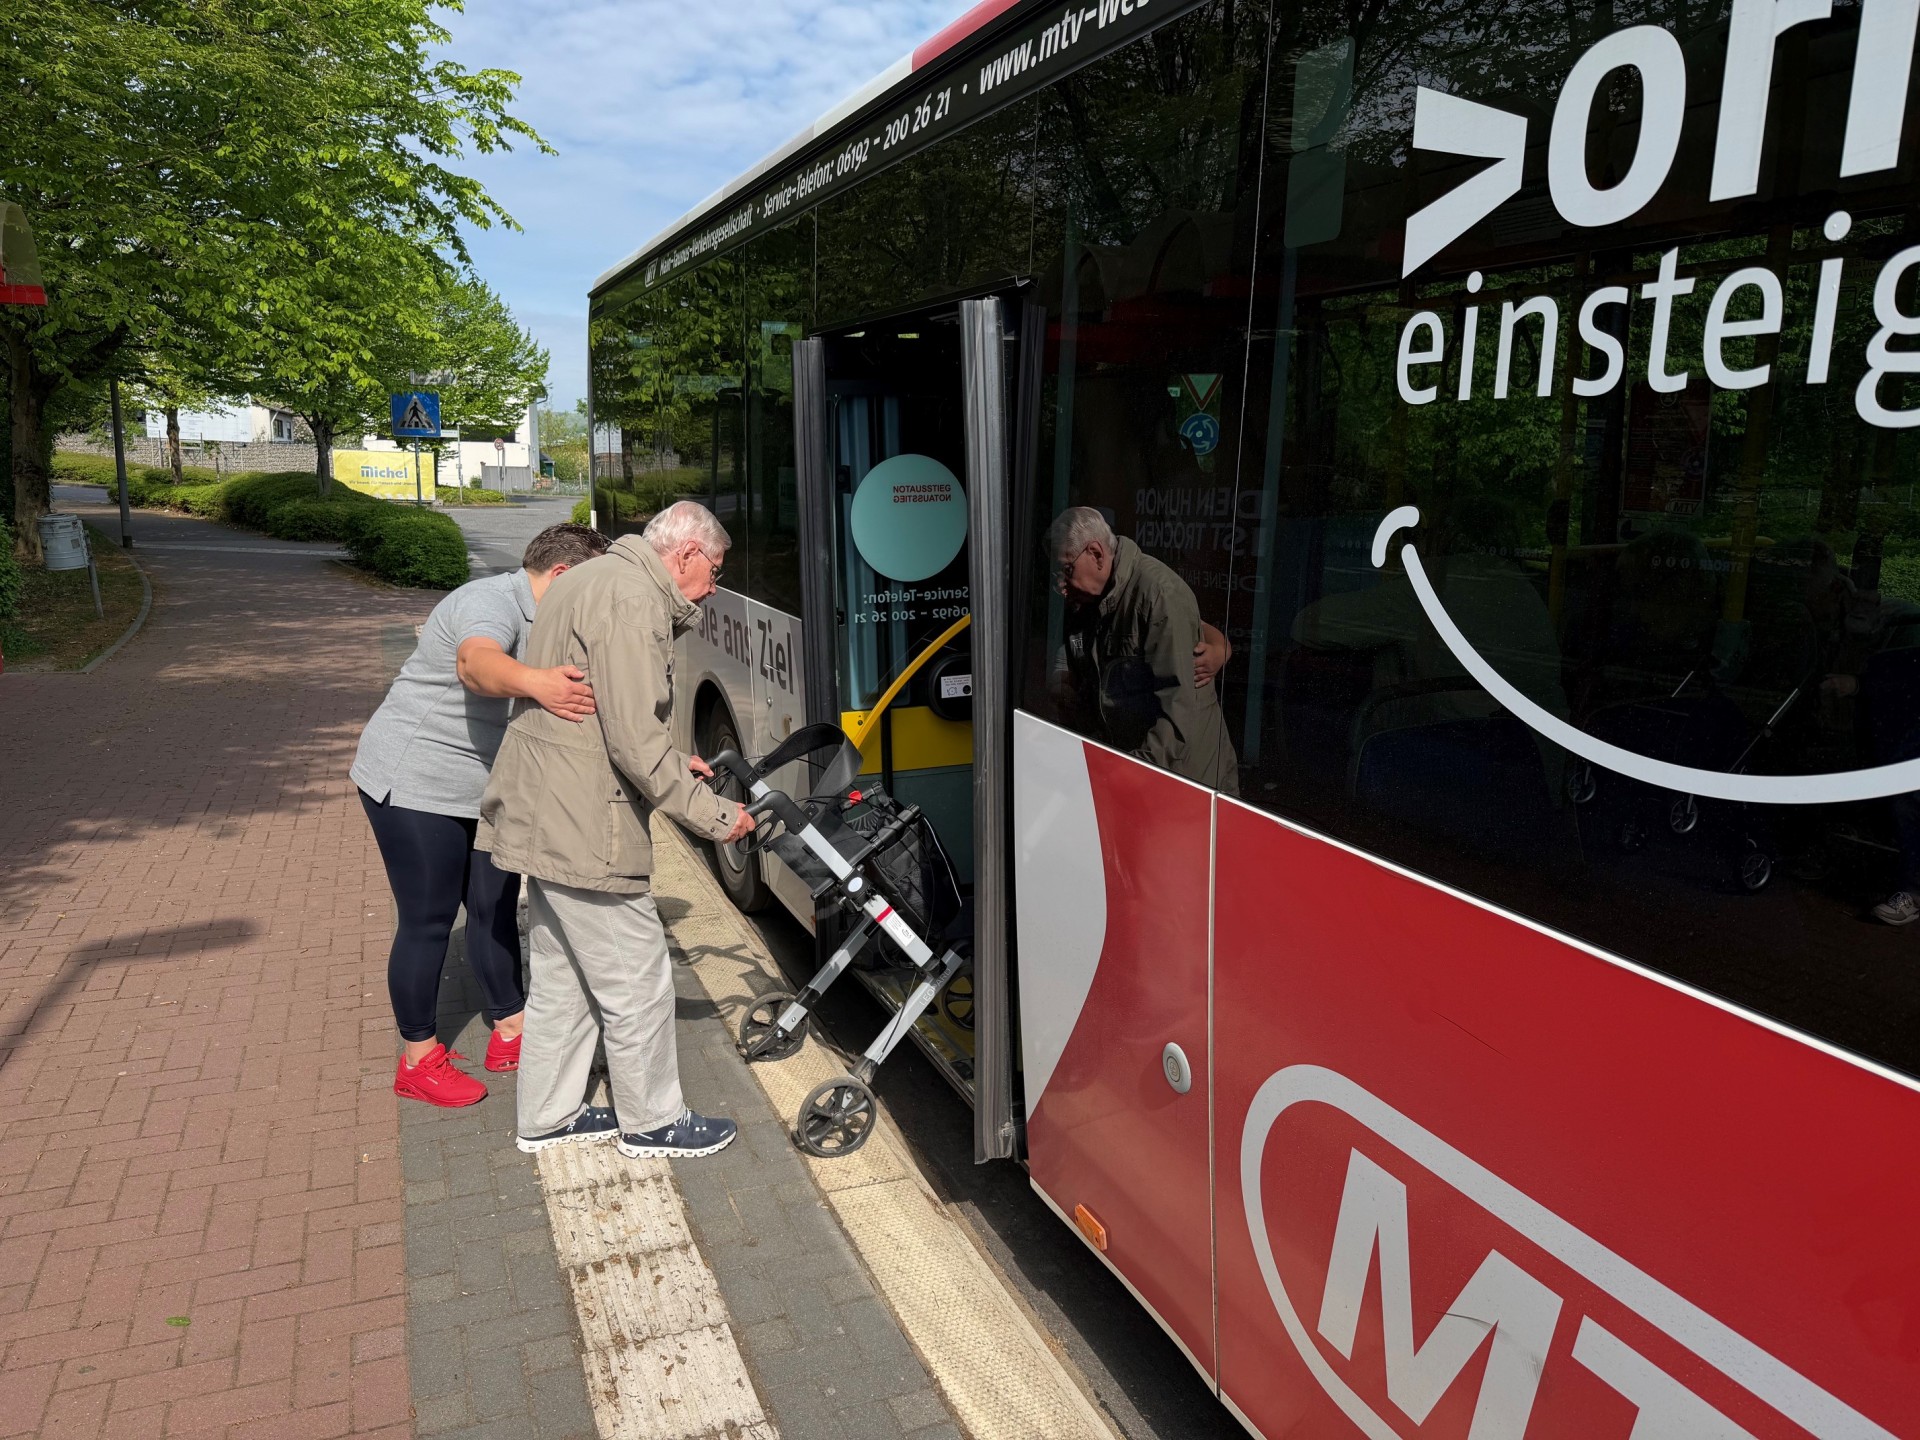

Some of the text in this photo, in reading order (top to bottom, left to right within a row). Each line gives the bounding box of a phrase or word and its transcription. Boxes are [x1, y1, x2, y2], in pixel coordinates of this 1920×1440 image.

[763, 160, 835, 219] Service-Telefon:
[836, 137, 870, 177] 06192
[883, 113, 910, 151] 200
[912, 92, 932, 134] 26
[934, 86, 951, 121] 21
[979, 0, 1150, 95] www.mtv-we
[893, 484, 951, 493] NOTAUSSTIEG
[723, 614, 753, 669] ans
[757, 618, 794, 695] Ziel
